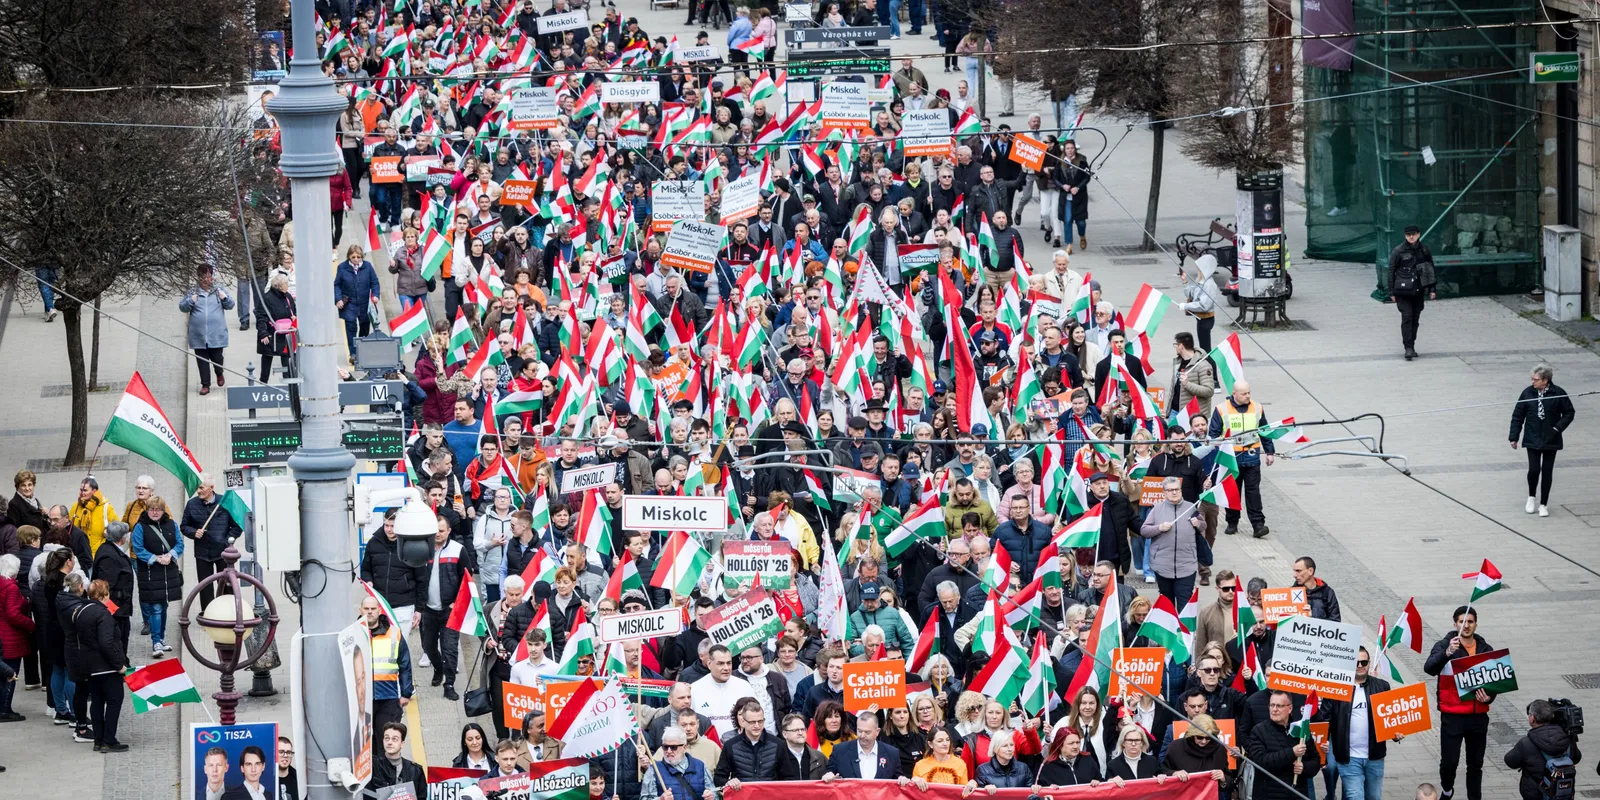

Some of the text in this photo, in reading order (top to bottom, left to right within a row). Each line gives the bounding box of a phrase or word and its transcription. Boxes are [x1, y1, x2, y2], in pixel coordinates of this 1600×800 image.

[546, 17, 579, 28] Miskolc
[822, 31, 861, 40] Városház
[683, 49, 711, 59] MISKOLC
[519, 90, 549, 99] Miskolc
[610, 86, 651, 98] Diósgyőr
[831, 86, 861, 94] Miskolc
[910, 113, 942, 121] Miskolc
[1015, 139, 1043, 158] Csöbör
[1016, 149, 1039, 164] Katalin
[505, 185, 534, 194] Csöbör
[730, 178, 754, 193] Miskolc
[681, 222, 716, 237] Miskolc
[666, 246, 715, 263] Csöbör Katalin
[573, 470, 605, 488] MISKOLC
[642, 505, 707, 521] Miskolc
[743, 544, 773, 554] DIÓSGYŐR
[727, 556, 769, 573] HOLLÓSY
[1263, 593, 1289, 602] FIDESZ
[720, 598, 751, 619] DIÓSGYŐR
[1273, 605, 1298, 613] BIZTOS
[618, 615, 665, 637] MISKOLC
[711, 612, 756, 644] HOLLÓSY
[1292, 621, 1348, 642] Miskolc
[736, 629, 767, 650] MISKOLC
[1279, 636, 1356, 654] Alsózsolca Felsőzsolca
[1276, 643, 1357, 663] Szirmabesenyő Sajókeresztúr
[1305, 656, 1325, 665] Arnót
[847, 671, 901, 687] Csöbör
[1272, 660, 1353, 683] Csöbör Katalin
[1457, 663, 1513, 689] Miskolc
[853, 685, 896, 700] Katalin
[1281, 680, 1306, 690] BIZTOS
[1307, 682, 1349, 696] VÁLASZTÁS
[1376, 695, 1424, 718] Csöbör
[1383, 710, 1422, 729] Katalin
[224, 731, 253, 741] TISZA
[533, 773, 587, 793] Alsózsolca
